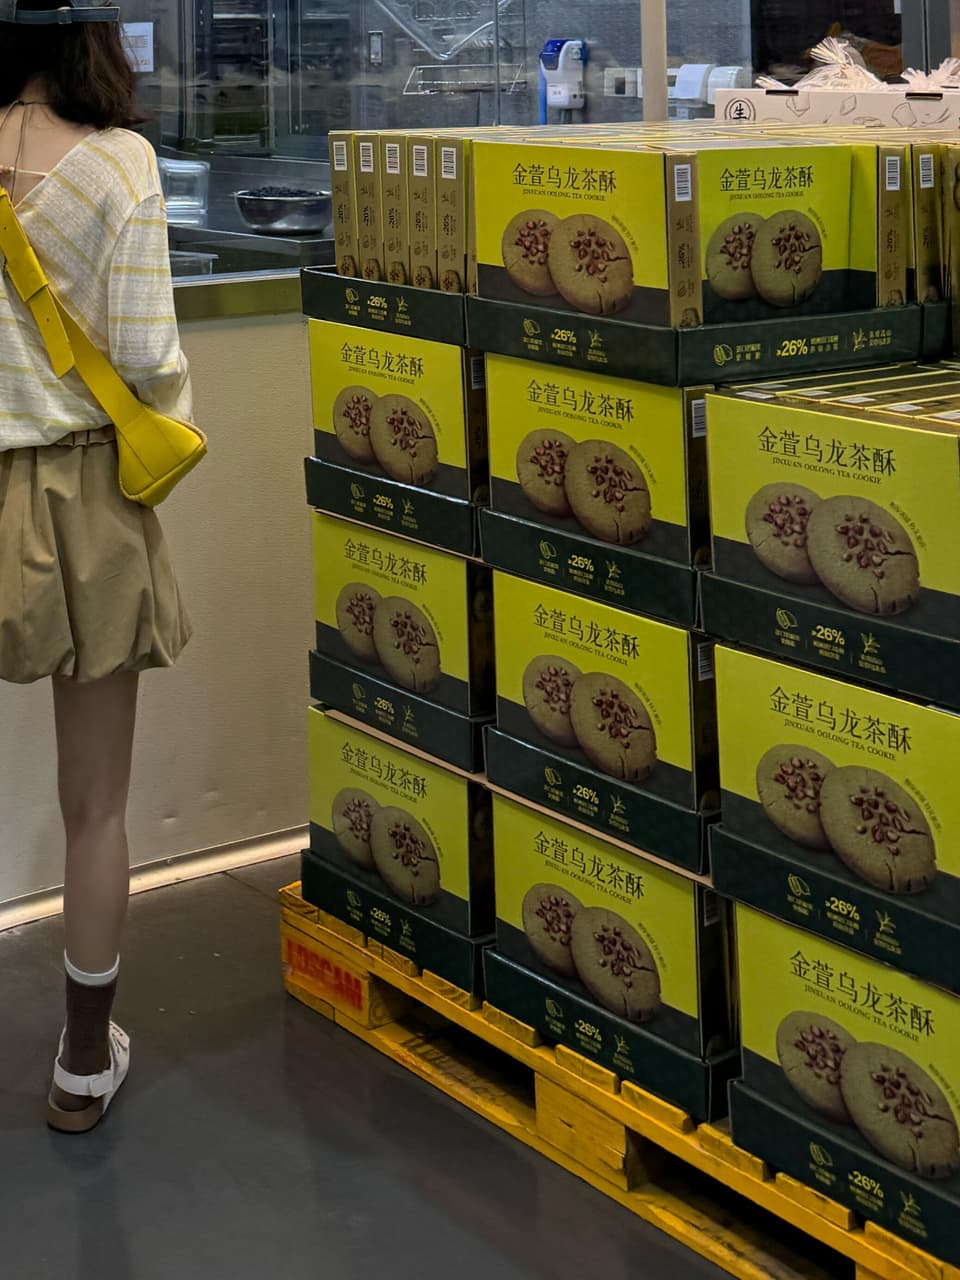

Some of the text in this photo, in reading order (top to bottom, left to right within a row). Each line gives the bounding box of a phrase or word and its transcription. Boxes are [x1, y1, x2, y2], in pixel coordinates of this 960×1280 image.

[512, 162, 617, 193] 金萱乌龙茶酥
[720, 165, 814, 191] 金萱乌龙茶酥
[340, 341, 424, 379] 金萱乌龙茶酥
[527, 379, 635, 422] 金萱乌龙茶酥
[758, 426, 897, 477] 金萱乌龙茶酥
[838, 469, 851, 479] TEA
[344, 537, 427, 585] 金萱乌龙茶酥
[534, 603, 640, 660] 金萱乌龙茶酥
[769, 685, 913, 755] 金萱乌龙茶酥
[817, 728, 849, 746] OOLONG
[851, 740, 866, 751] TEA
[866, 745, 897, 761] COOKIE
[341, 741, 427, 798] 金萱乌龙茶酥
[534, 831, 645, 899] 金萱乌龙茶酥
[790, 950, 935, 1037] 金萱乌龙茶酥
[873, 1015, 887, 1028] TEA
